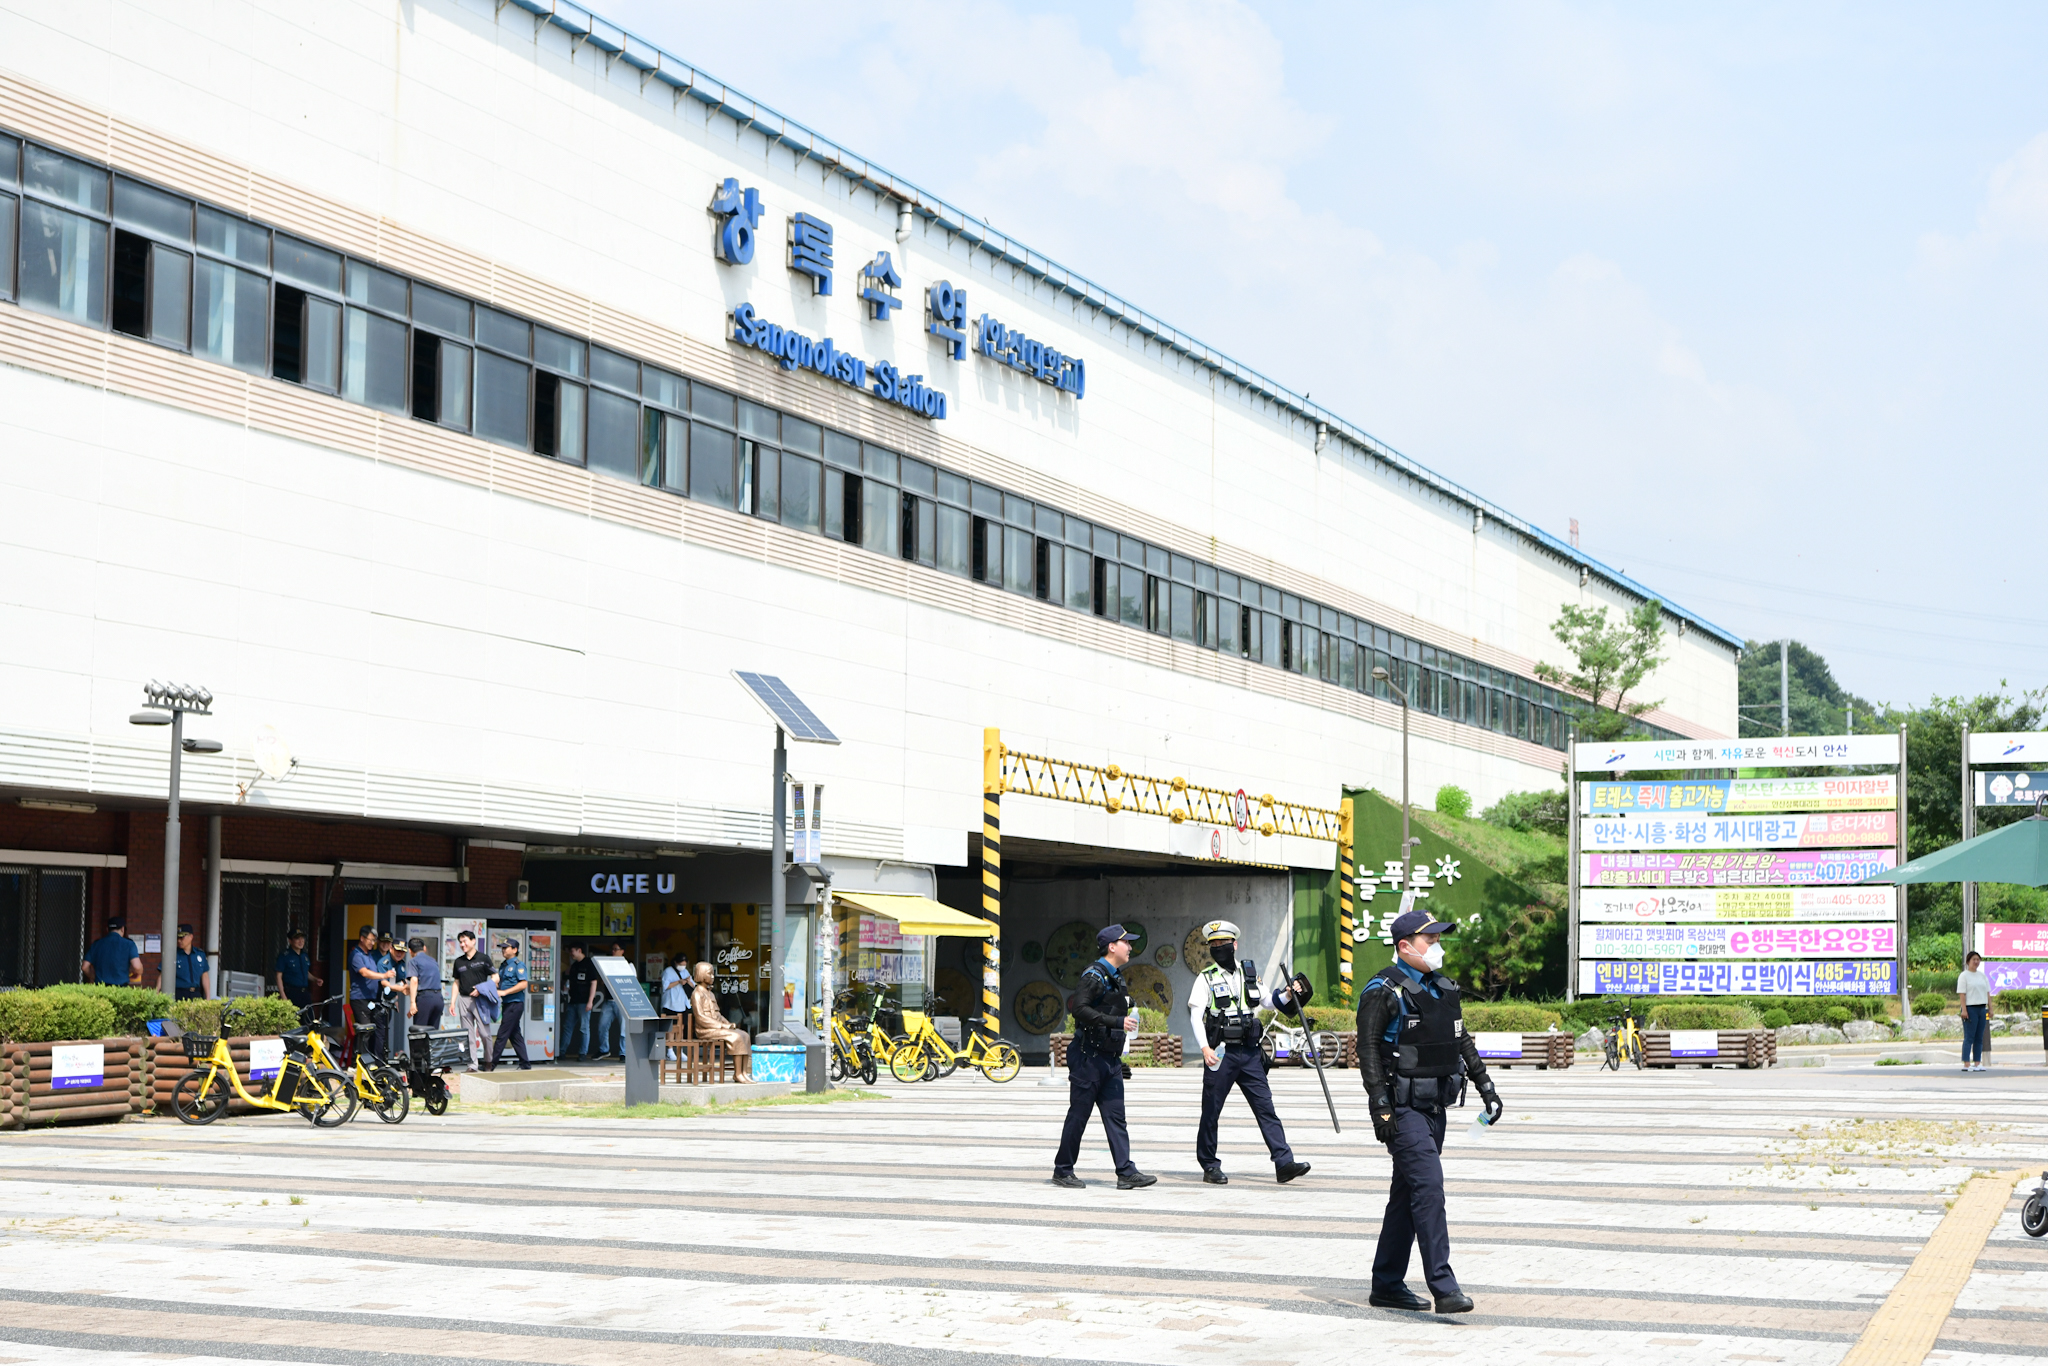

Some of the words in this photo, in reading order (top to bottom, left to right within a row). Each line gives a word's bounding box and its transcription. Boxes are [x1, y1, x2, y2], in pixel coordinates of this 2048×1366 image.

[714, 178, 967, 361] 상록수역
[735, 302, 867, 388] Sangnoksu
[873, 359, 947, 420] Station
[1654, 749, 1687, 761] 시민과
[1721, 747, 1767, 759] 자유로운
[1772, 745, 1817, 758] 혁신도시
[1823, 744, 1848, 757] 안산
[1824, 780, 1889, 795] 무이자할부
[1592, 786, 1634, 809] 토레스
[1638, 785, 1667, 809] 즉시
[1669, 784, 1725, 809] 출고가능
[1714, 820, 1798, 843] 게시대광고
[1831, 815, 1886, 831] 준디자인
[590, 872, 649, 894] CAFE
[656, 873, 675, 894] U
[1353, 861, 1435, 901] 늘푸른
[1669, 870, 1709, 884] 큰방3
[1604, 902, 1633, 913] 조가네
[1595, 928, 1643, 941] 휠체어타고
[1688, 928, 1726, 941] 옥상산책
[717, 946, 753, 965] Coffee
[1594, 944, 1683, 955] 010-3401-5967
[1698, 944, 1726, 955] 한대앞역
[1597, 963, 1659, 984] 엔비의원
[1815, 963, 1891, 981] 485-7550
[1605, 984, 1623, 993] 안산
[1625, 984, 1650, 993] 시흥점
